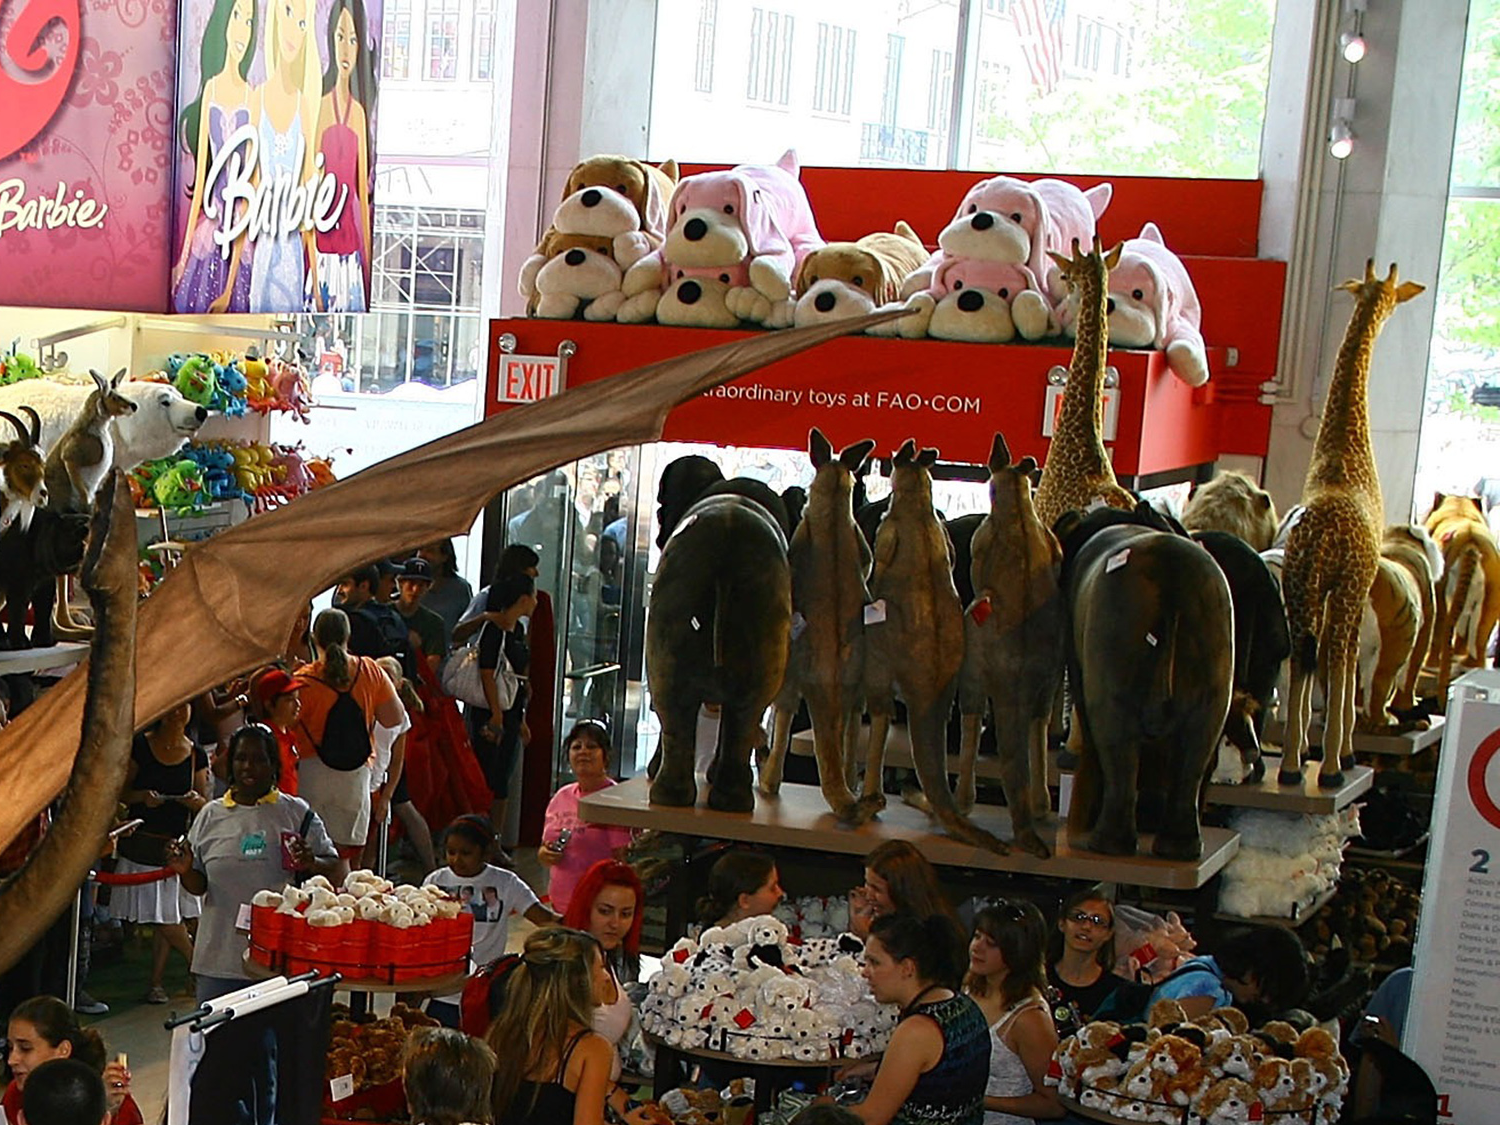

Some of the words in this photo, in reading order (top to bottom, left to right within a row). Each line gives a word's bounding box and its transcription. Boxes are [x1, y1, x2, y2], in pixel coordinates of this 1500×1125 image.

[506, 361, 556, 401] EXIT
[808, 388, 846, 408] toys
[852, 392, 870, 408] at
[1468, 848, 1490, 874] 2
